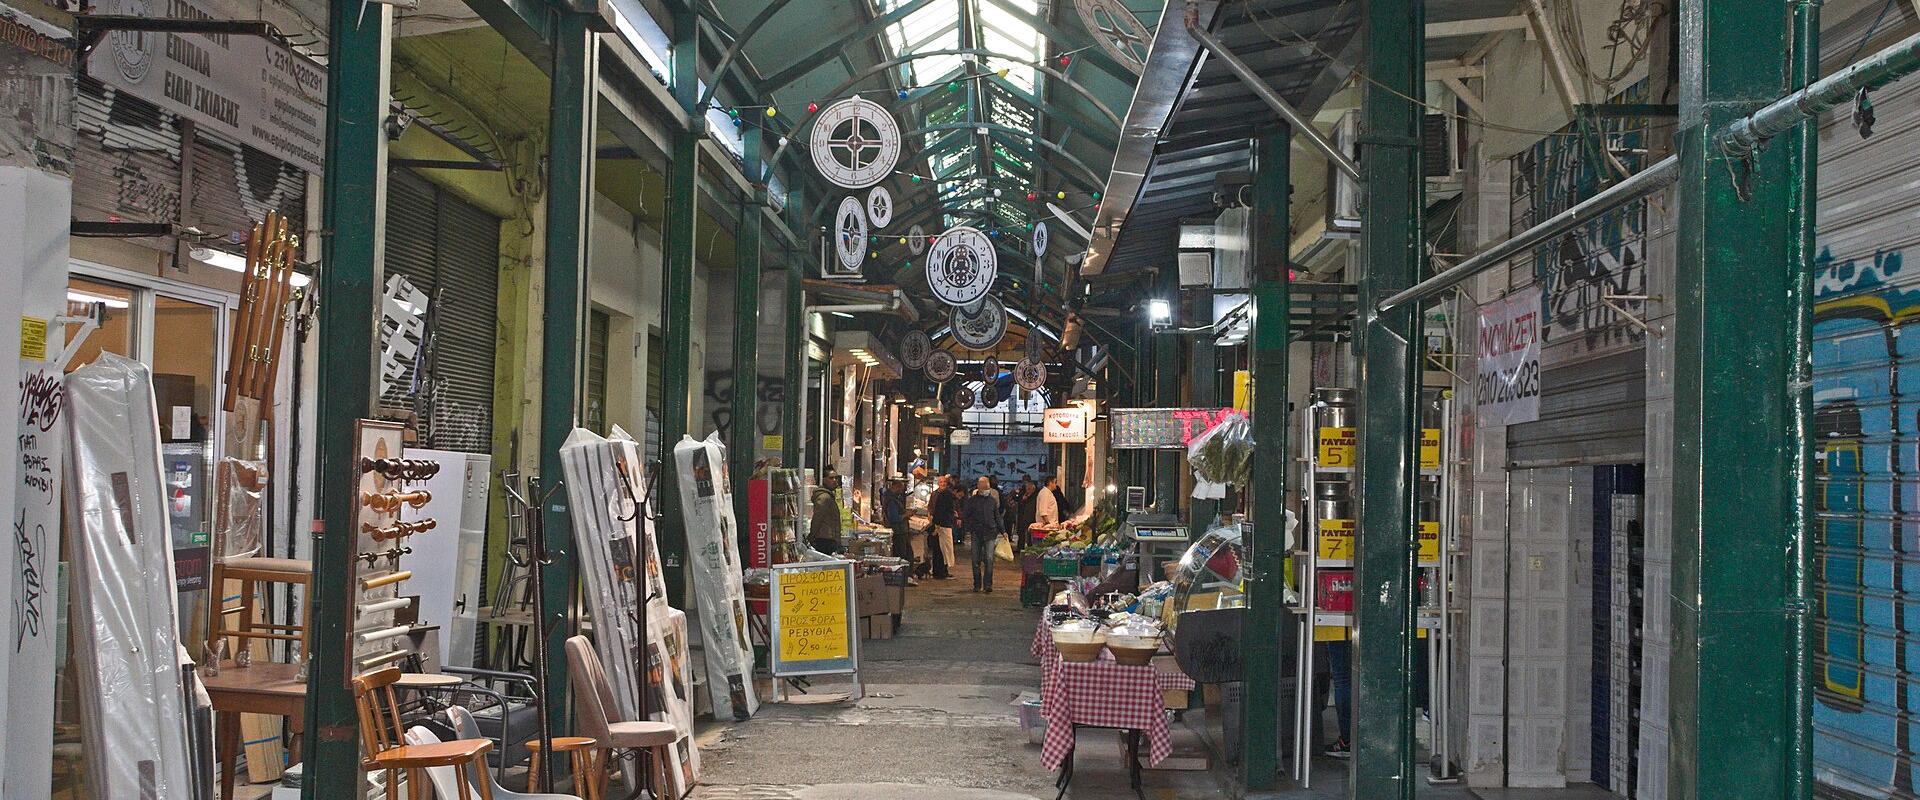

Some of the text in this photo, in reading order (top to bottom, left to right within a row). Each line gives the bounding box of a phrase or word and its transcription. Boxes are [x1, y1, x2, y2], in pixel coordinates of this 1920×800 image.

[166, 31, 211, 78] ΕΠΙΠΛΑ
[164, 70, 192, 108] ΕΙΔΗ
[194, 84, 241, 129] ΣΚΙΑΣΗΣ
[1327, 447, 1343, 465] 5
[756, 522, 768, 564] Panini
[1326, 538, 1343, 559] 7
[783, 585, 796, 602] 5
[788, 626, 833, 638] ΡΕΒΥΘΙΑ
